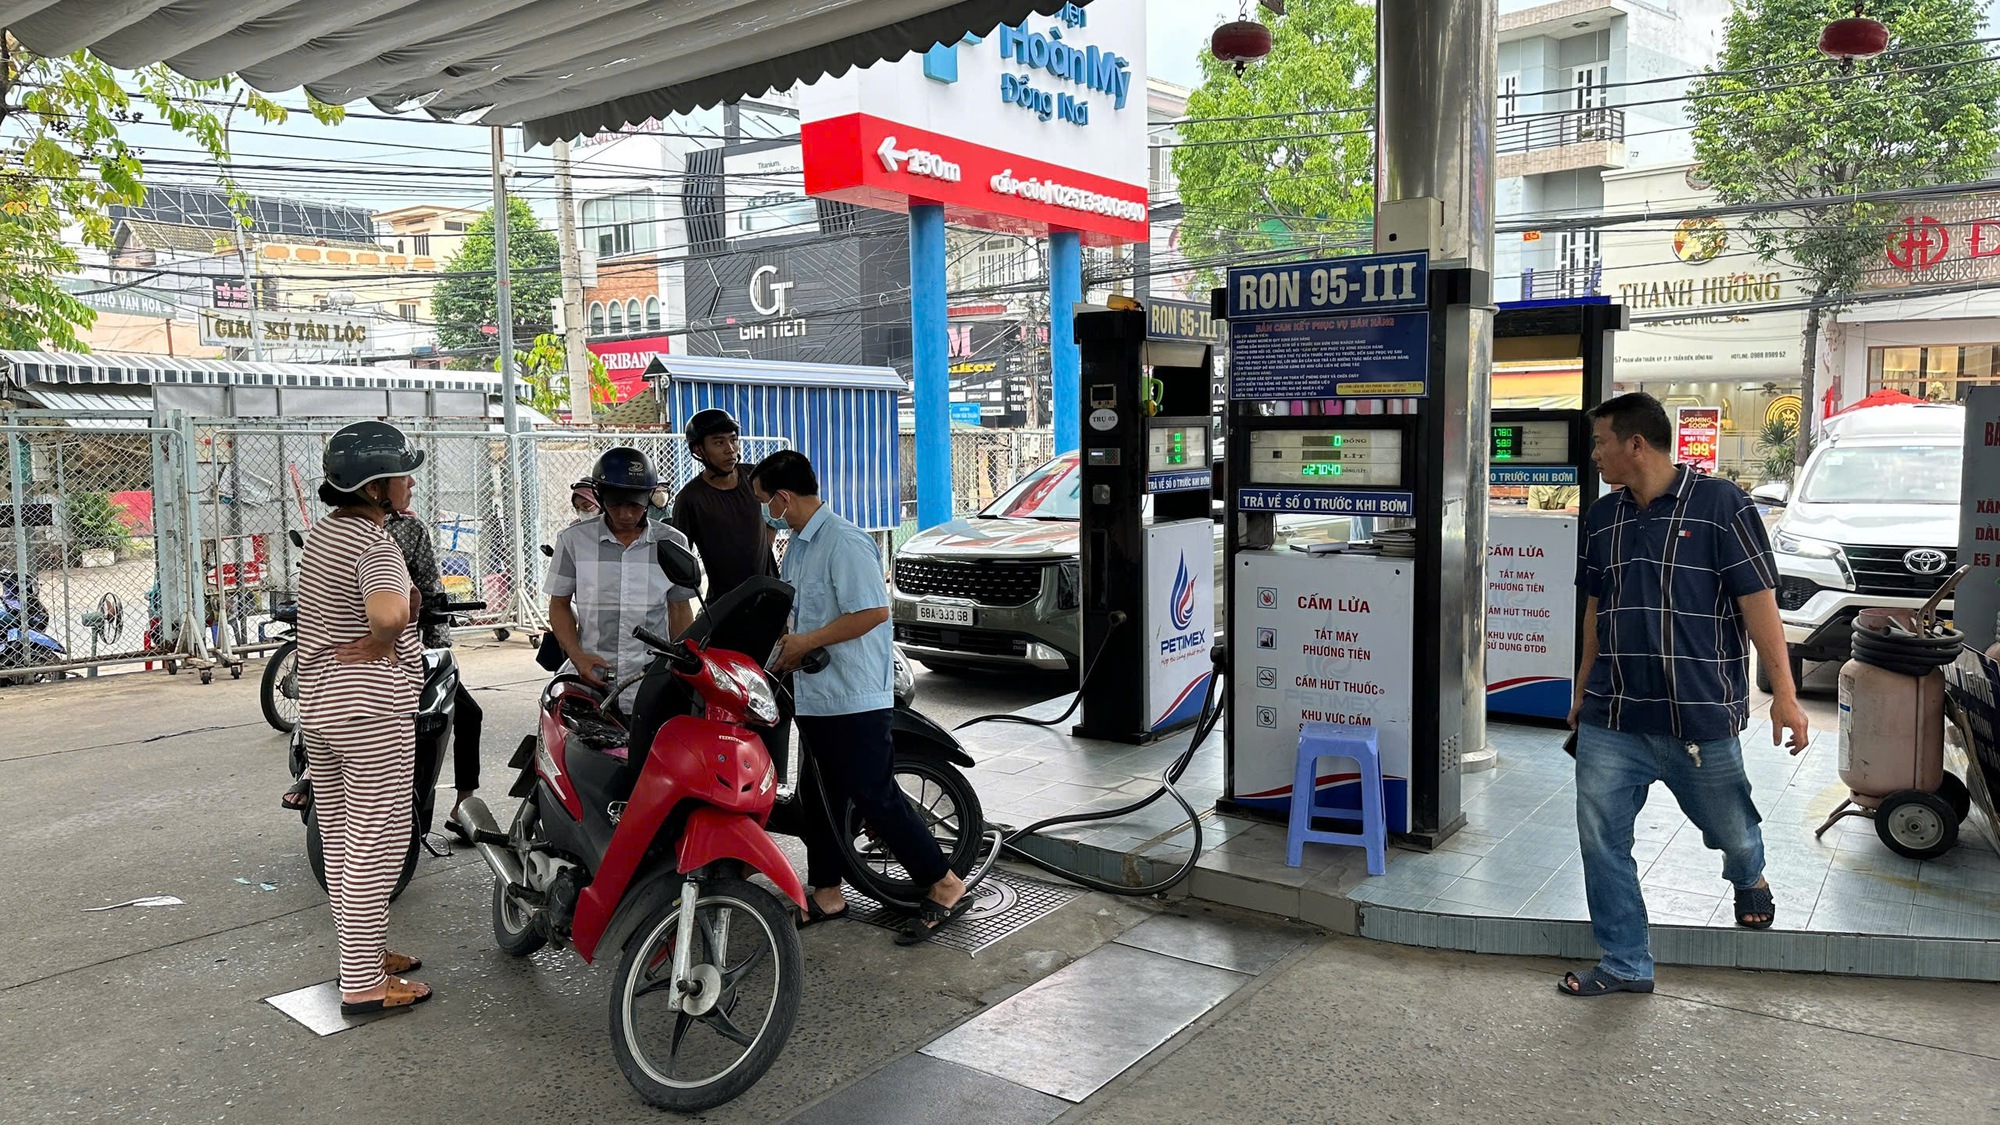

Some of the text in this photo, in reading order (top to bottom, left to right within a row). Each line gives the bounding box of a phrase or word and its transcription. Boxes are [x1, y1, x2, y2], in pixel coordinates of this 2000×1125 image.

[1057, 92, 1089, 126] Nai
[1239, 262, 1417, 311] RON 95-III
[1619, 271, 1781, 309] THANH HƯƠNG
[1151, 305, 1218, 338] RON 95-III
[295, 319, 328, 341] TÂN
[333, 321, 366, 347] LỘC
[600, 351, 658, 370] GRIBAN
[1092, 416, 1106, 425] TRỤ
[1333, 435, 1342, 447] 0
[1499, 471, 1530, 482] TRƯỚC
[1532, 473, 1549, 482] KHI
[1552, 472, 1573, 482] BƠM
[1243, 492, 1407, 513] TRẢ VỀ SỐ 0 TRƯỚC KHI BƠM
[1488, 543, 1544, 558] CẤM LỬA
[1974, 553, 1990, 567] E5
[1499, 569, 1535, 579] TẮT MÁY
[1489, 582, 1545, 593] PHƯƠNG TIỆN
[1297, 593, 1371, 614] CẤM LỬA
[1488, 604, 1550, 618] ẤM HÚT THUỐC
[921, 607, 968, 622] 68A-333.68
[1161, 628, 1206, 656] PETIMEX
[1314, 627, 1359, 643] TẮT MÁY
[1487, 631, 1505, 640] KHU
[1526, 632, 1545, 642] CẤM
[1303, 644, 1371, 662] PHƯƠNG TIỆN
[1498, 643, 1522, 653] DỤNG
[1524, 645, 1547, 653] ĐTDĐ
[1295, 674, 1378, 695] CẤM HÚT THUỐC
[1301, 709, 1322, 722] KHU
[1348, 712, 1372, 726] CẤM
